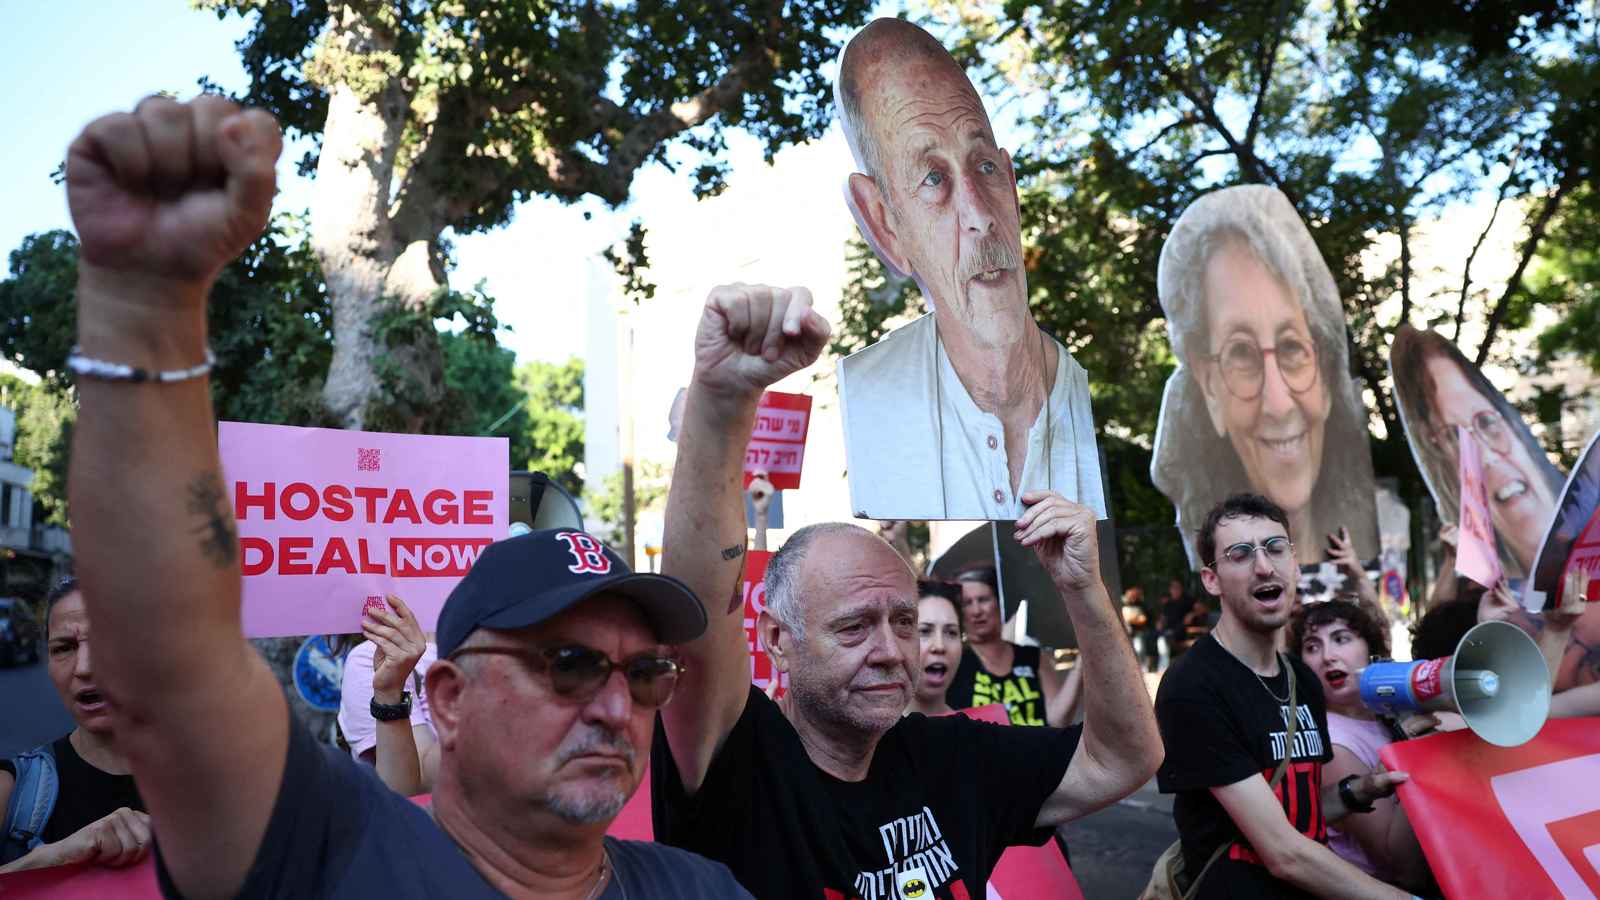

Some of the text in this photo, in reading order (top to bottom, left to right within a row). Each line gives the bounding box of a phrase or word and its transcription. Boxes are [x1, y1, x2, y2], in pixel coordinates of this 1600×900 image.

[235, 481, 493, 525] HOSTAGE
[239, 538, 486, 576] DEAL NOW
[555, 531, 611, 574] B
[903, 840, 959, 888] אות
